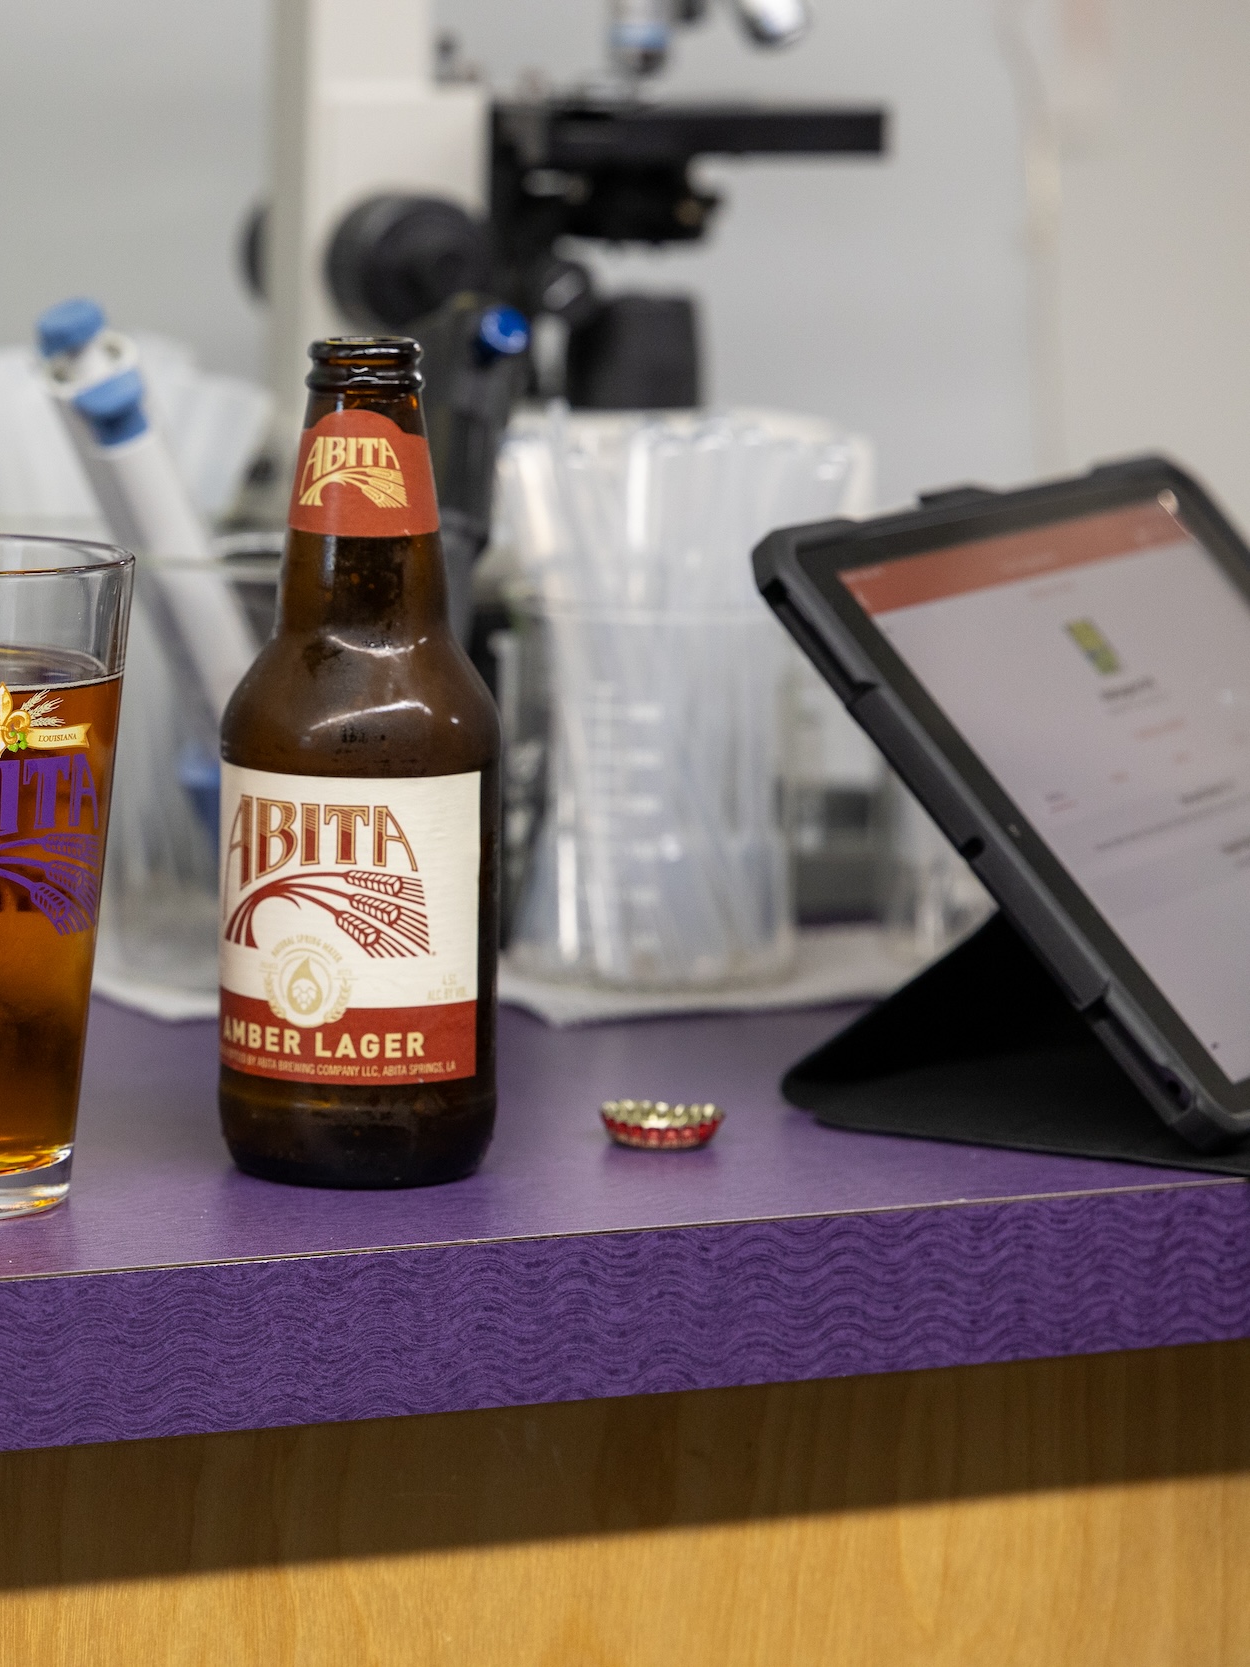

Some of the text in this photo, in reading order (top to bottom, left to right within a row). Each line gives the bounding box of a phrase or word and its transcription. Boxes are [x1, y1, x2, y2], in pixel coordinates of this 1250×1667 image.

[299, 436, 401, 497] ABITA
[38, 733, 77, 743] LOUISIANA
[224, 794, 419, 920] ABITA
[223, 1015, 301, 1056] AMBER
[314, 1031, 425, 1059] LAGER
[257, 1056, 278, 1070] ABITA
[278, 1060, 316, 1075] BREWING
[316, 1063, 360, 1077] COMPANY
[361, 1065, 381, 1077] LLC,
[382, 1064, 408, 1077] ABITA
[409, 1061, 445, 1075] SPRINGS,
[446, 1060, 457, 1072] LA
